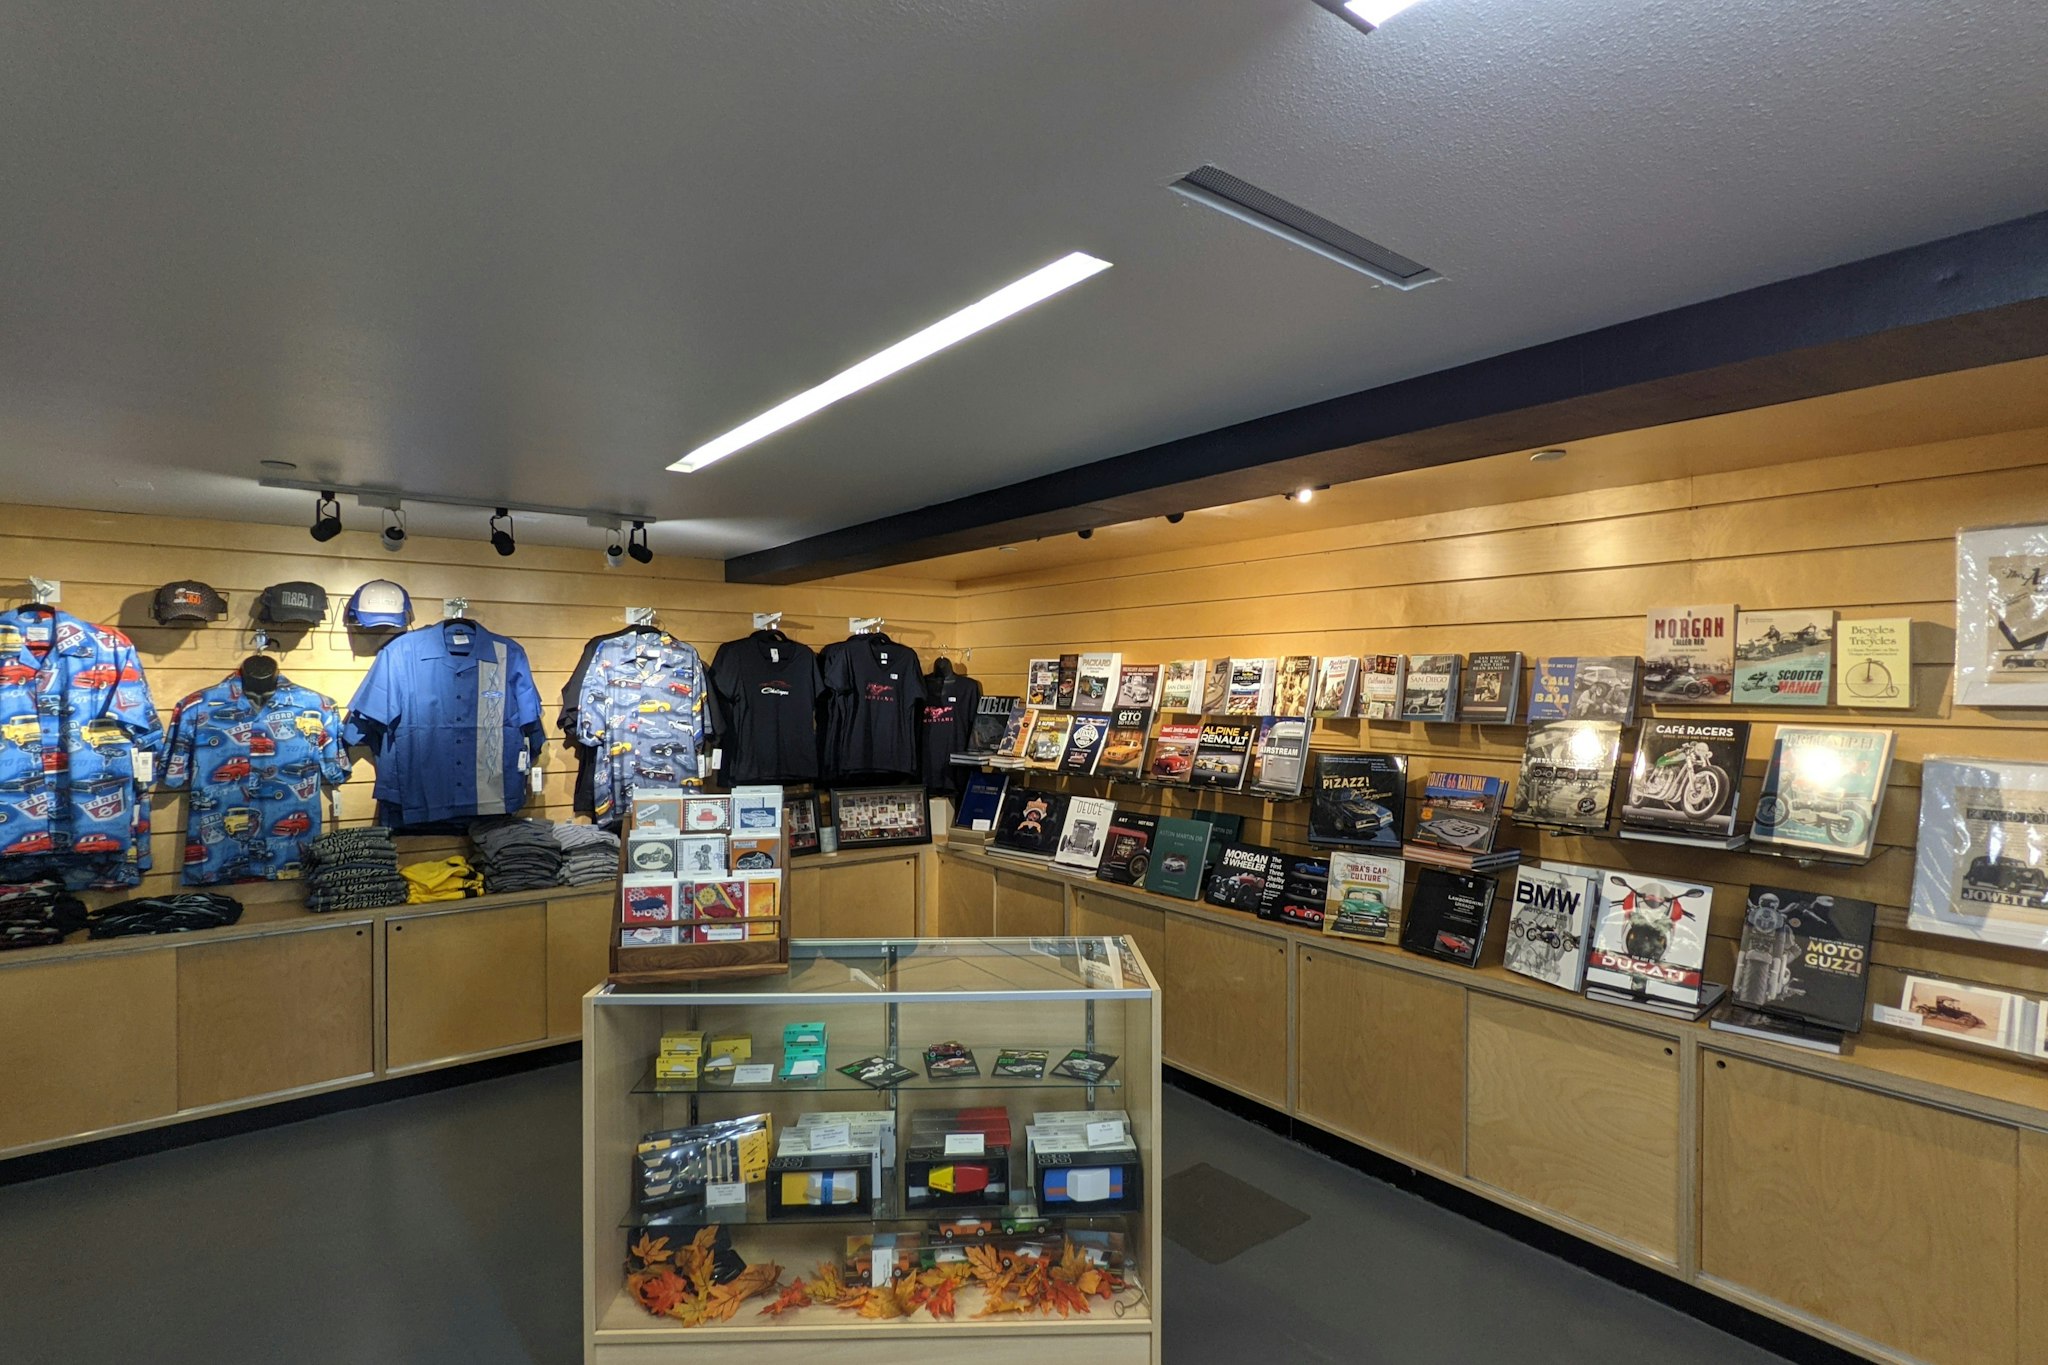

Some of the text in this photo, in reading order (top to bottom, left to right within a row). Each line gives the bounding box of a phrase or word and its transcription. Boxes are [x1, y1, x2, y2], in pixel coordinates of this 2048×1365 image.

[1654, 617, 1724, 639] MORGAN
[1851, 625, 1895, 636] Bicycles
[1849, 637, 1897, 648] Tricycles
[1082, 658, 1112, 667] PACKARD
[1540, 676, 1570, 686] CALL
[1777, 670, 1823, 680] SCOOTER
[1778, 681, 1823, 694] MANIA!
[1534, 692, 1570, 703] BAJA
[269, 711, 292, 721] FORD
[1118, 711, 1142, 721] GTO
[1203, 726, 1241, 736] ALPINE
[1656, 724, 1734, 736] CAFÉ RACERS
[1200, 734, 1248, 746] RENAULT
[1260, 746, 1299, 756] AIRSTREAM
[1322, 776, 1370, 789] PIZAZZ!
[1446, 774, 1457, 789] 66
[1457, 774, 1487, 791] RAILWAY
[83, 793, 119, 810] FORD
[1077, 801, 1104, 816] DEUCE
[1160, 829, 1175, 837] ASTON
[1176, 832, 1195, 841] MARTIN
[1225, 849, 1269, 864] MORGAN
[1222, 857, 1266, 872] 3 WHEELER
[1346, 864, 1387, 875] CUBA'S CAR
[1269, 869, 1285, 877] Three
[1350, 873, 1382, 882] CULTURE
[1265, 882, 1284, 890] Cobras
[1267, 875, 1285, 885] Shelby
[1448, 894, 1484, 907] LAMBORGHINI
[1516, 880, 1581, 915] BMW
[1962, 888, 2030, 906] JOWETT
[1523, 906, 1568, 922] MOTORCYCLES
[1807, 940, 1864, 960] MOTO
[1601, 955, 1686, 982] DUCATI
[1804, 953, 1862, 975] GUZZI
